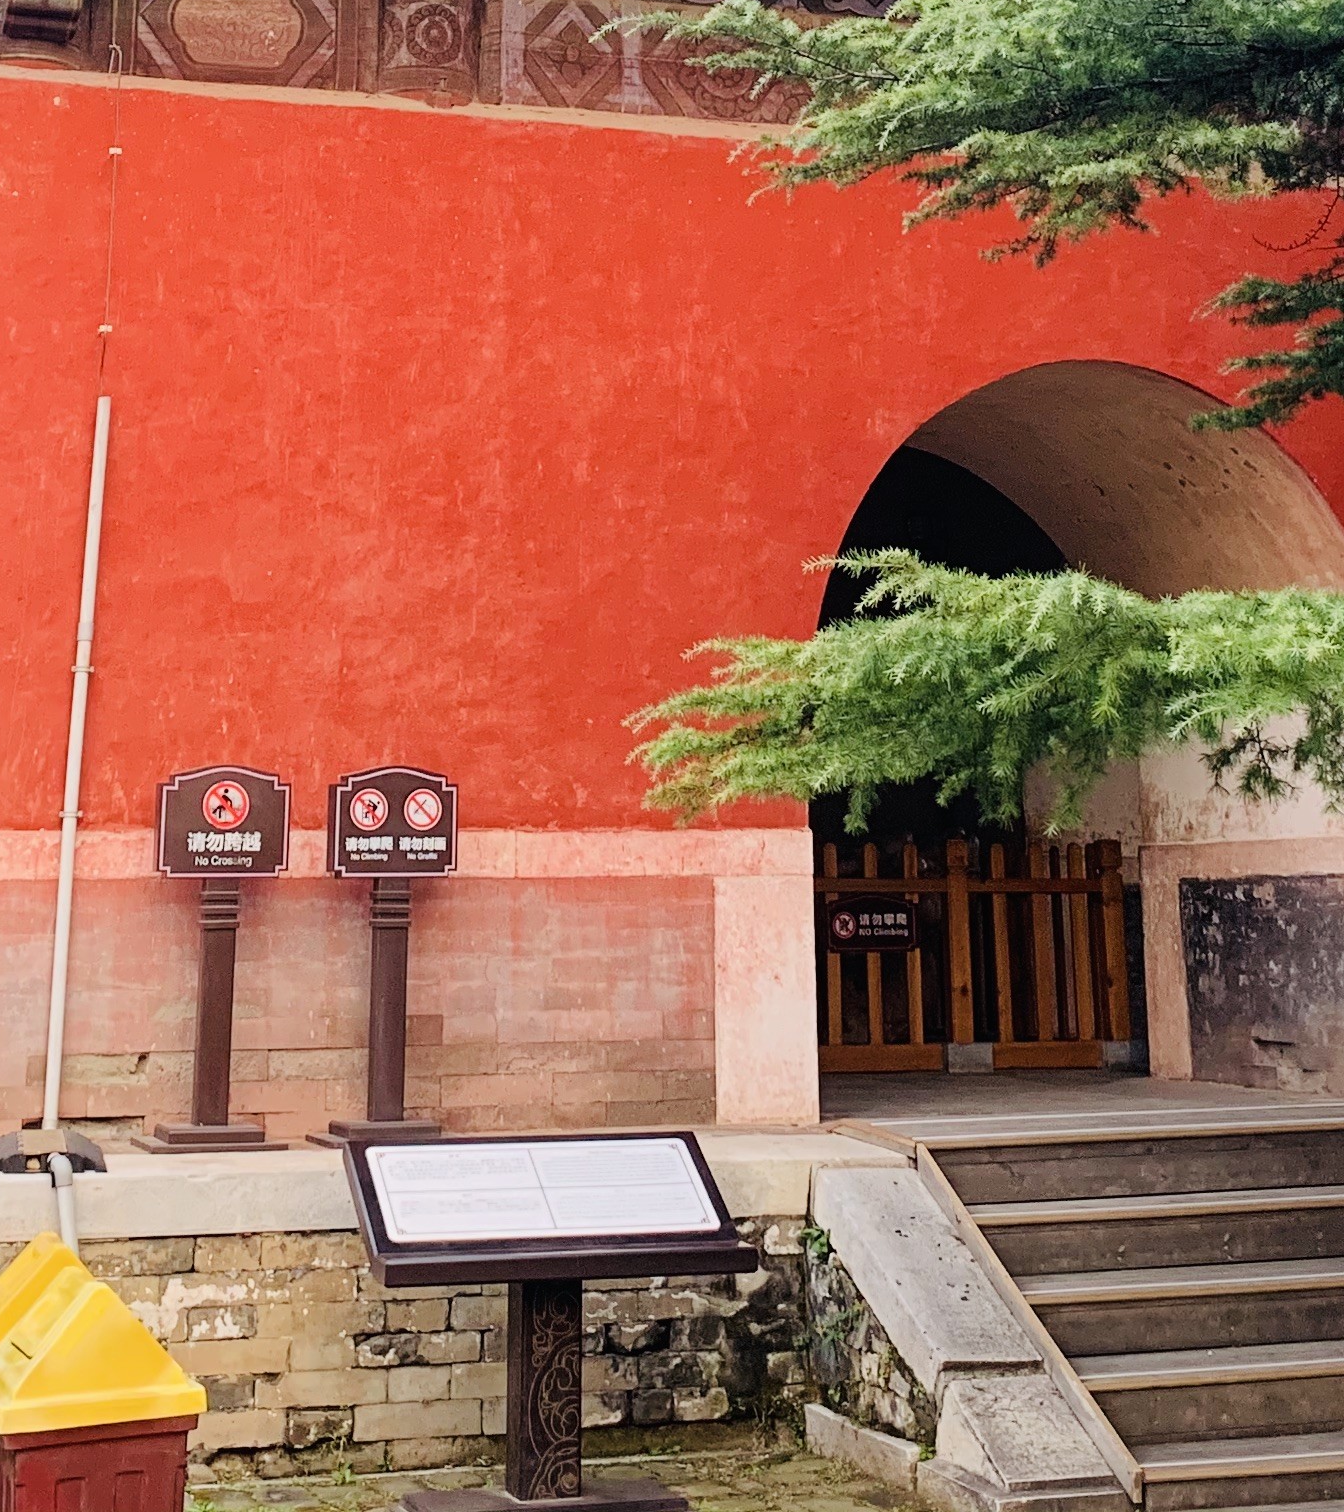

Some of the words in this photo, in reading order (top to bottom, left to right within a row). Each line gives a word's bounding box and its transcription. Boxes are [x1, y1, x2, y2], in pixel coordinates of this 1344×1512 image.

[188, 831, 261, 852] 请勿跨越
[345, 836, 393, 851] 请勿攀爬
[195, 855, 209, 865] No
[211, 854, 252, 867] Crossing
[351, 852, 360, 860] No
[361, 852, 389, 861] Climbing
[407, 852, 416, 860] No
[859, 913, 907, 925] 请勿攀爬
[859, 928, 871, 936] NO
[874, 927, 909, 937] Climbing
